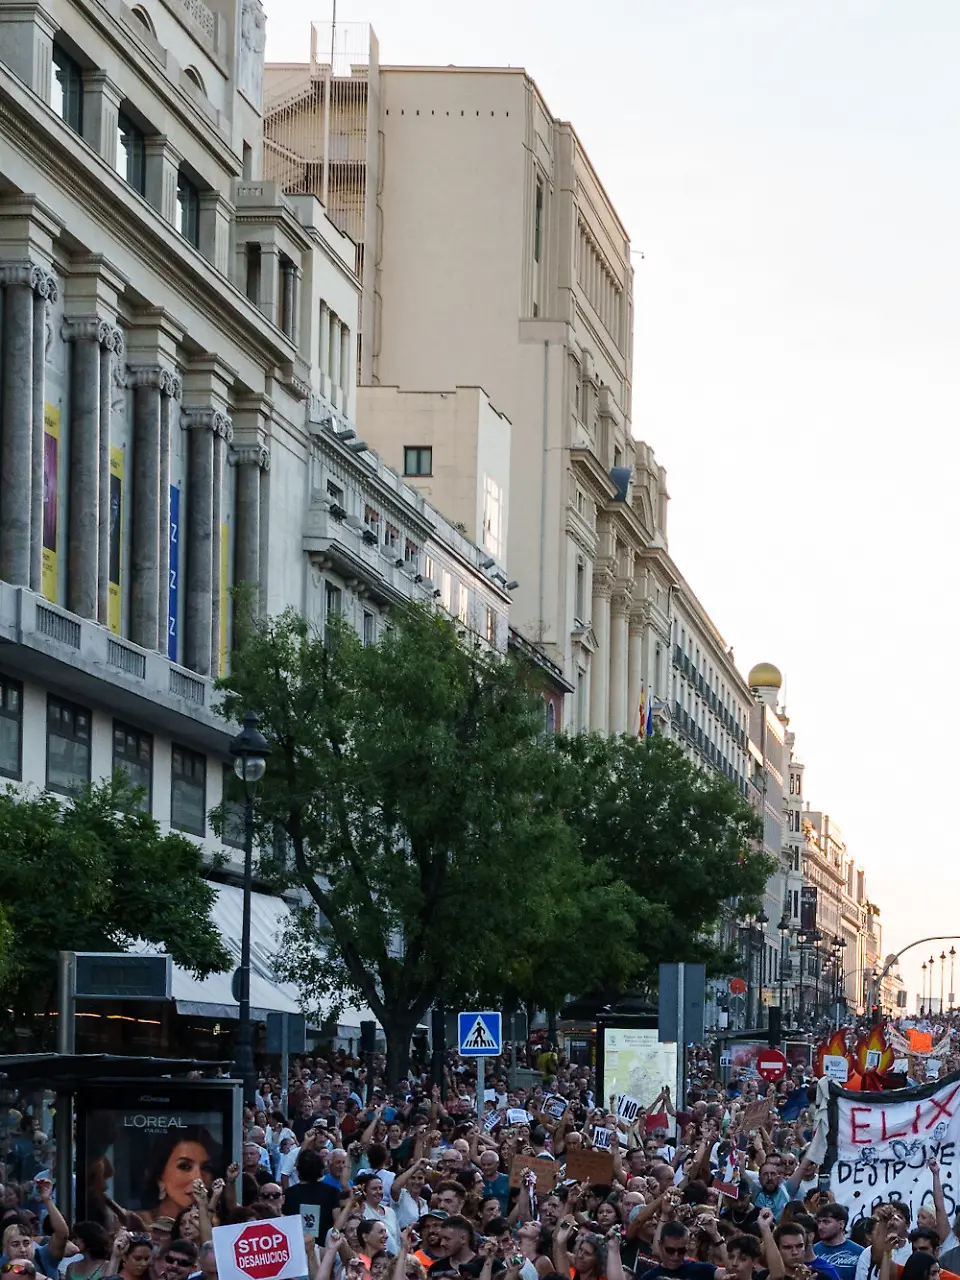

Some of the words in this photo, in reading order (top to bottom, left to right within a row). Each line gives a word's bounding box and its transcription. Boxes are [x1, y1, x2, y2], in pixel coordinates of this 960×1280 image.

[851, 1083, 960, 1144] ELIX
[238, 1233, 283, 1254] STOP
[238, 1249, 289, 1270] DESAHUCIOS
